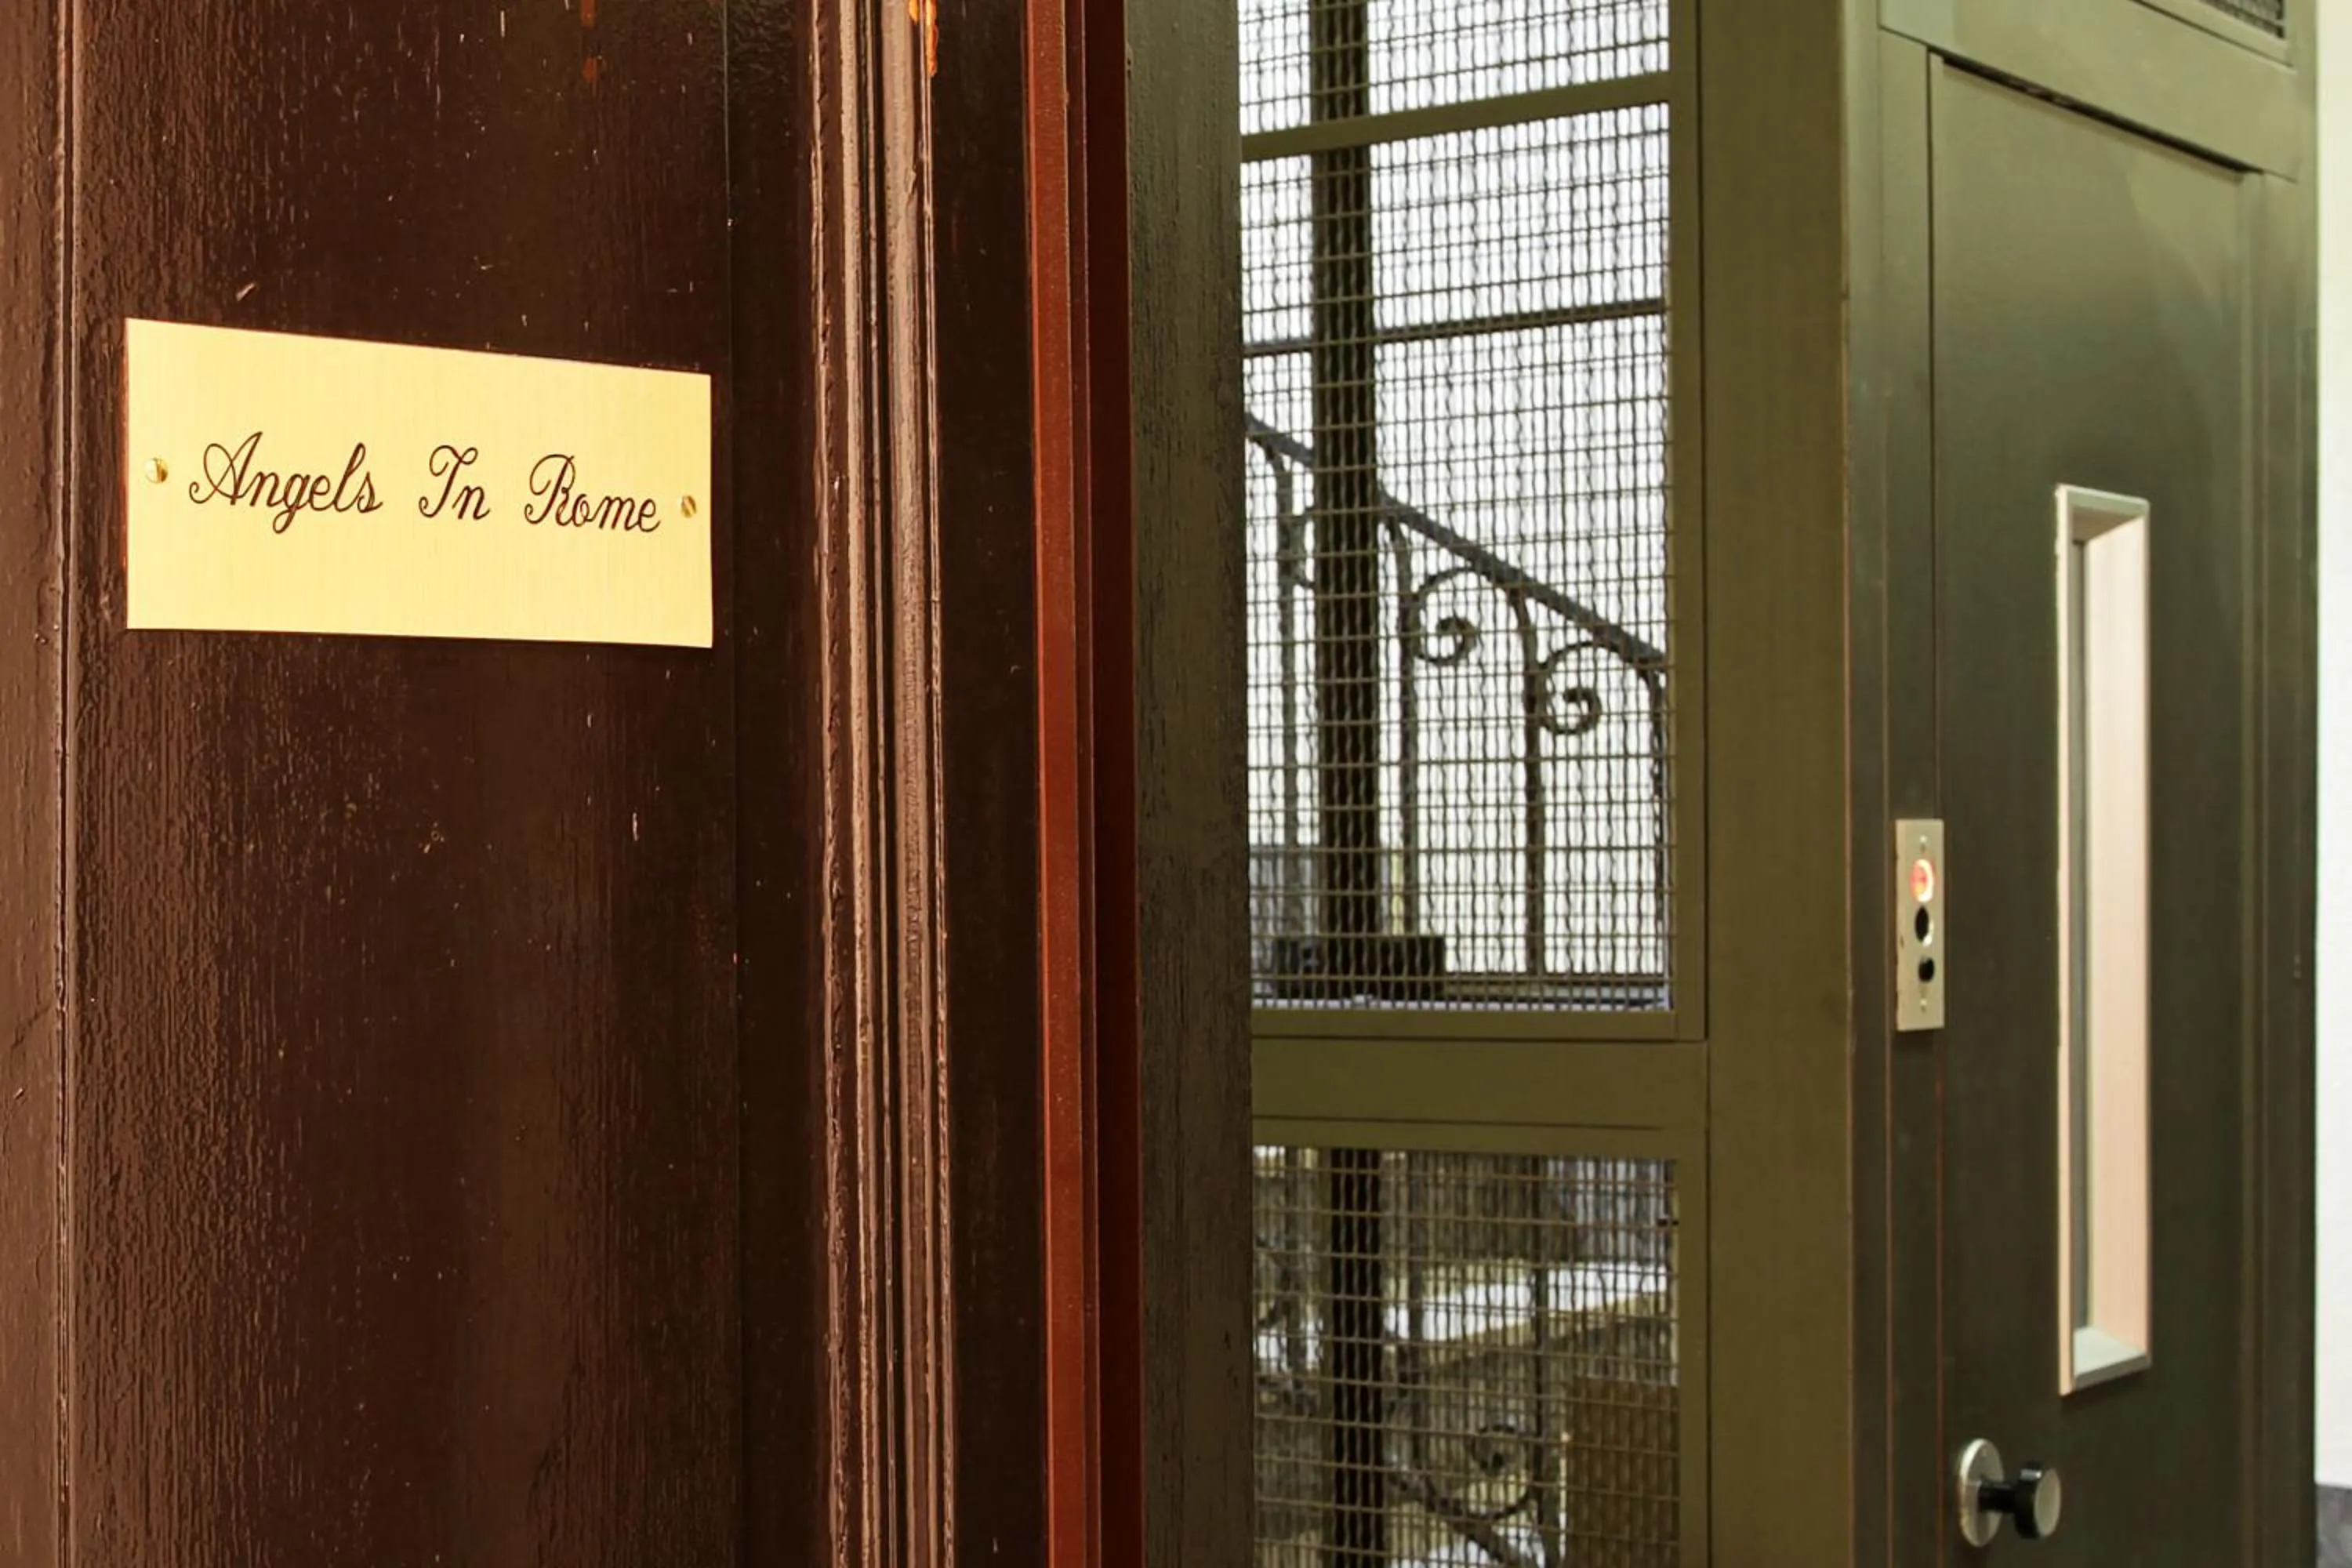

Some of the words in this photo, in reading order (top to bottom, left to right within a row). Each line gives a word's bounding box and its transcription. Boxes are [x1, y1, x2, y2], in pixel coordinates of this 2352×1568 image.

[189, 431, 383, 534] Angels
[418, 445, 490, 521] In
[524, 454, 660, 532] Rome
